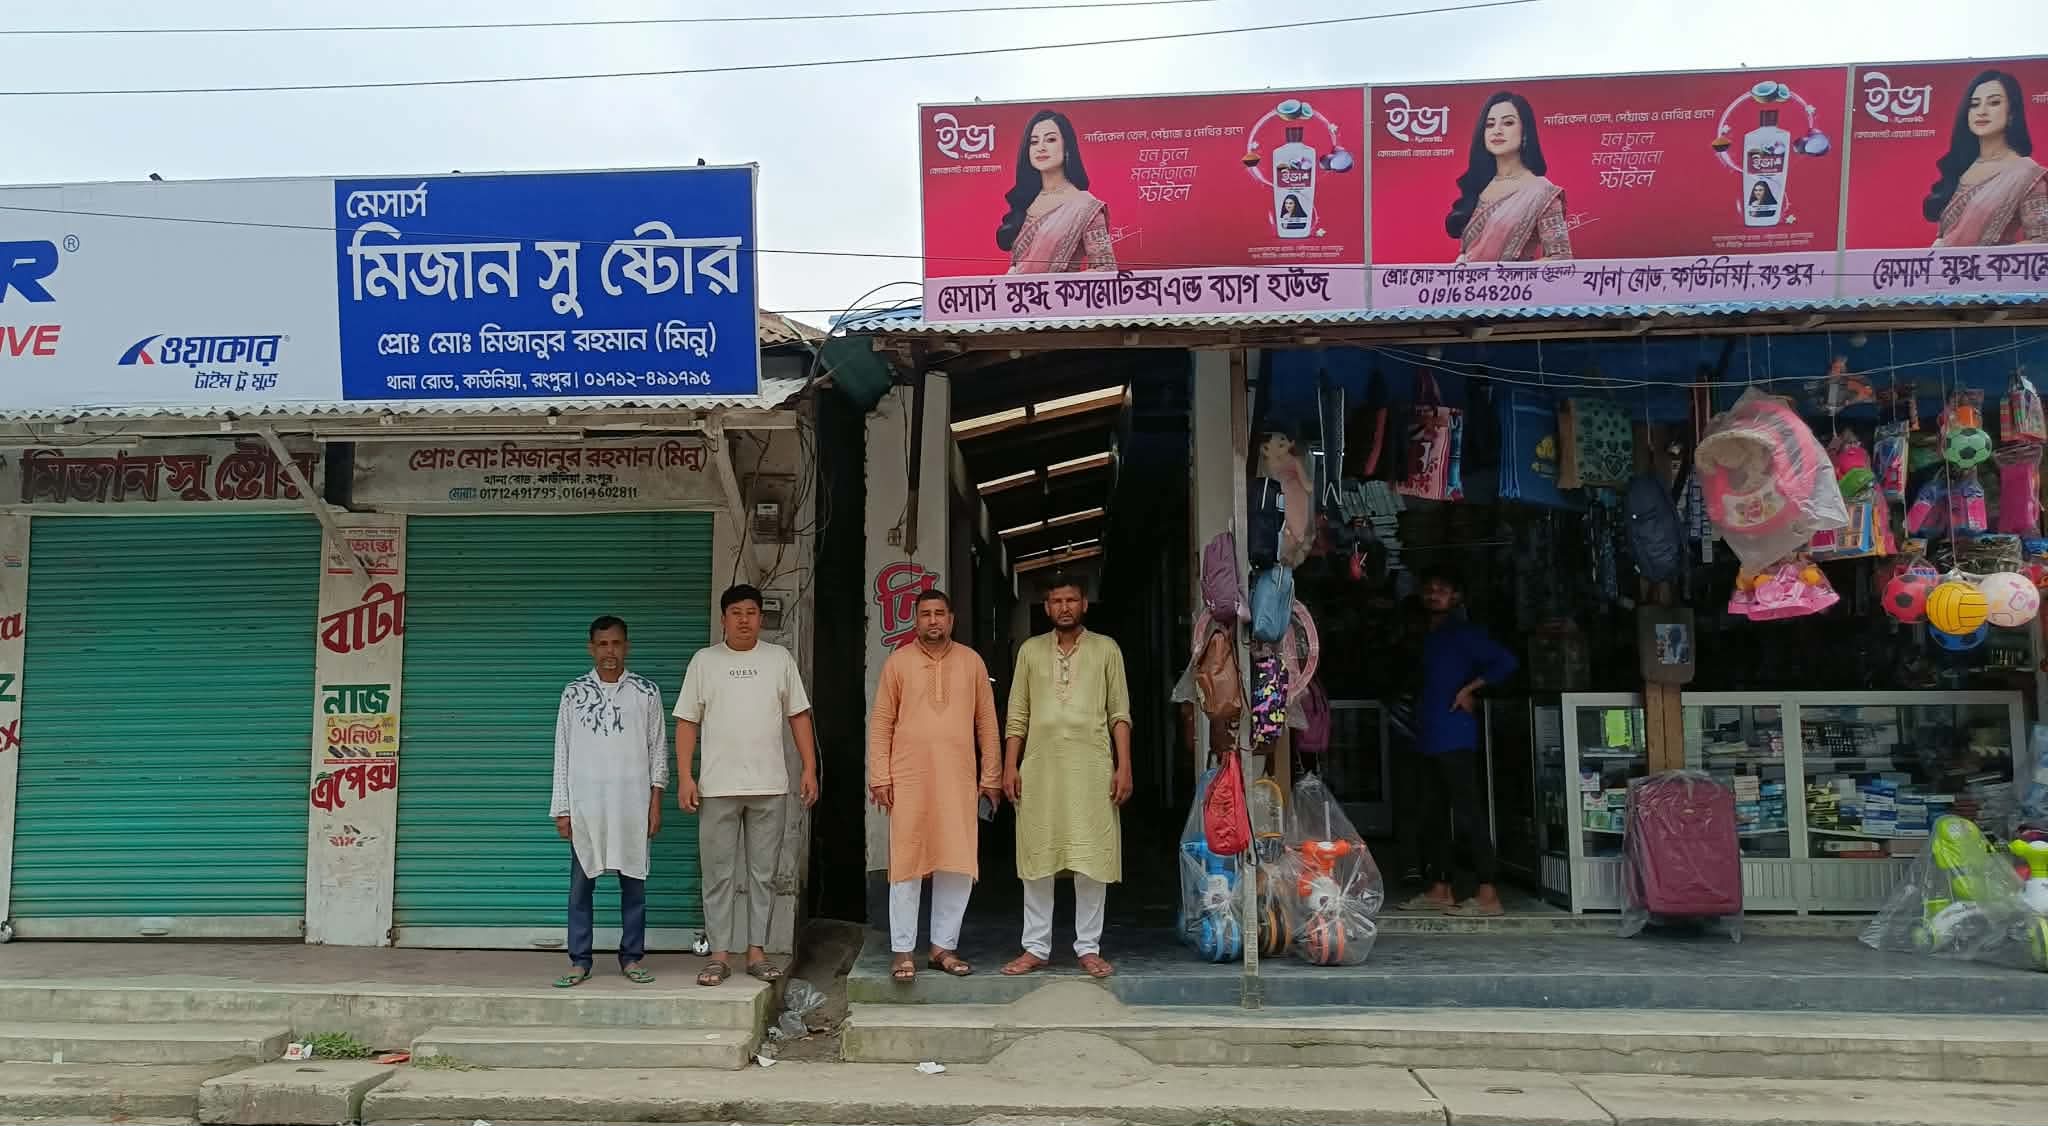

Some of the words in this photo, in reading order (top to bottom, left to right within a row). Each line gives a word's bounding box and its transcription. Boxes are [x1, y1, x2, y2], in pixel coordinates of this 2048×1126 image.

[1864, 72, 1932, 122] ইভা
[1384, 93, 1450, 142] ইভা
[933, 112, 996, 159] ইভা
[1138, 181, 1192, 202] স্টাইল
[1600, 166, 1656, 189] স্টাইল
[346, 182, 428, 218] মেসার্স
[0, 240, 59, 303] R
[347, 221, 521, 301] মিজান
[535, 241, 584, 319] সু
[1873, 251, 1934, 290] মেসার্স
[938, 279, 997, 314] মেসার্স
[1208, 274, 1260, 304] ব্যাগ
[1266, 267, 1331, 302] হাউজ
[1418, 285, 1533, 305] 01916848206
[160, 334, 282, 368] ওয়াকার
[479, 323, 566, 360] মিজানুর
[572, 329, 648, 353] রহমান
[655, 320, 717, 358] (মিনু)
[194, 371, 234, 390] টাইম
[386, 374, 417, 390] থানা
[584, 370, 712, 388] ০১৭১২-৪৯১৭৯৫
[500, 441, 583, 473] মিজানুর
[585, 446, 657, 469] রহমান
[658, 440, 708, 472] (মিনু)
[729, 668, 759, 677] GUESS
[322, 683, 391, 715] নাজ
